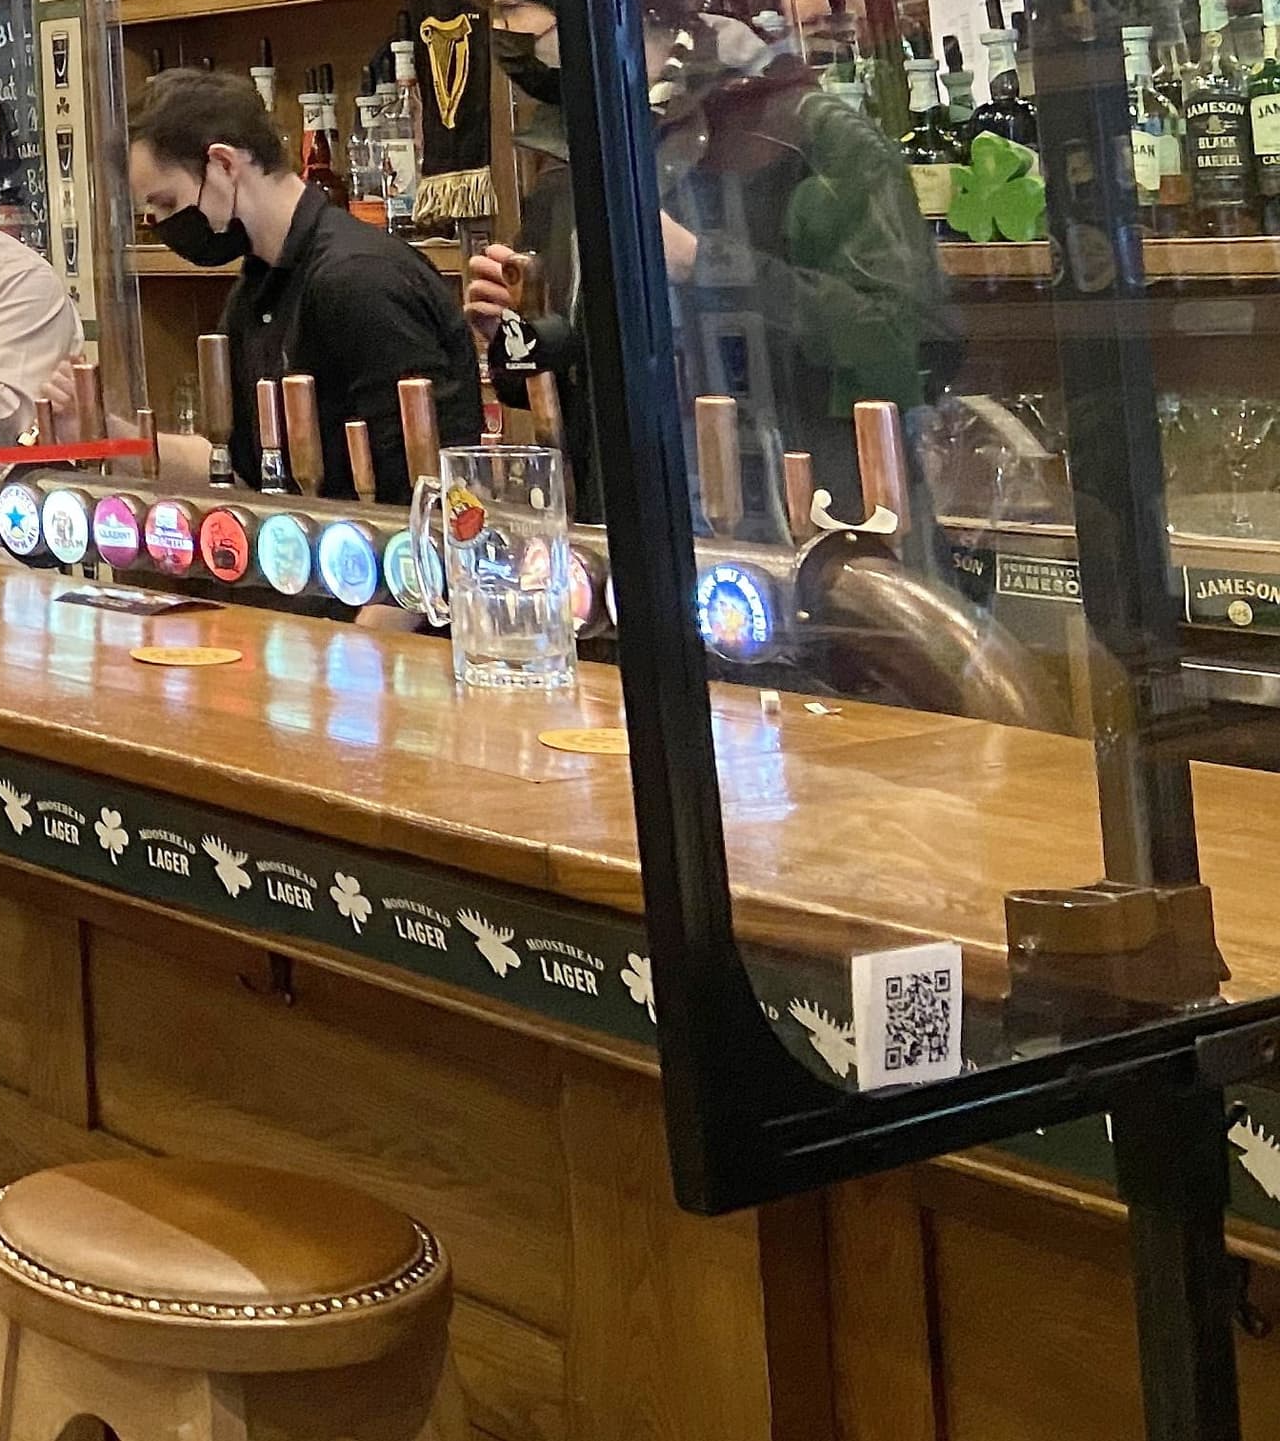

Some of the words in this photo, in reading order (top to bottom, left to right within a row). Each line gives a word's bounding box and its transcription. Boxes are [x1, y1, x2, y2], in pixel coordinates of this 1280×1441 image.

[1186, 101, 1245, 120] JAMESON
[1198, 135, 1237, 150] BLACK
[1002, 573, 1080, 596] JAMESO
[1196, 579, 1280, 605] JAMESON
[37, 799, 86, 826] MOOSEHEAD
[43, 815, 81, 846] LAGER
[139, 827, 197, 856] MOOSEHEAD
[146, 844, 191, 878] LAGER
[255, 859, 319, 890] MOOSEHEAD
[266, 876, 315, 912] LAGER
[381, 896, 452, 929] MOOSEHEAD
[393, 915, 448, 952] LAGER
[525, 937, 605, 972] MOOSEHEAD
[539, 956, 599, 997] LAGER
